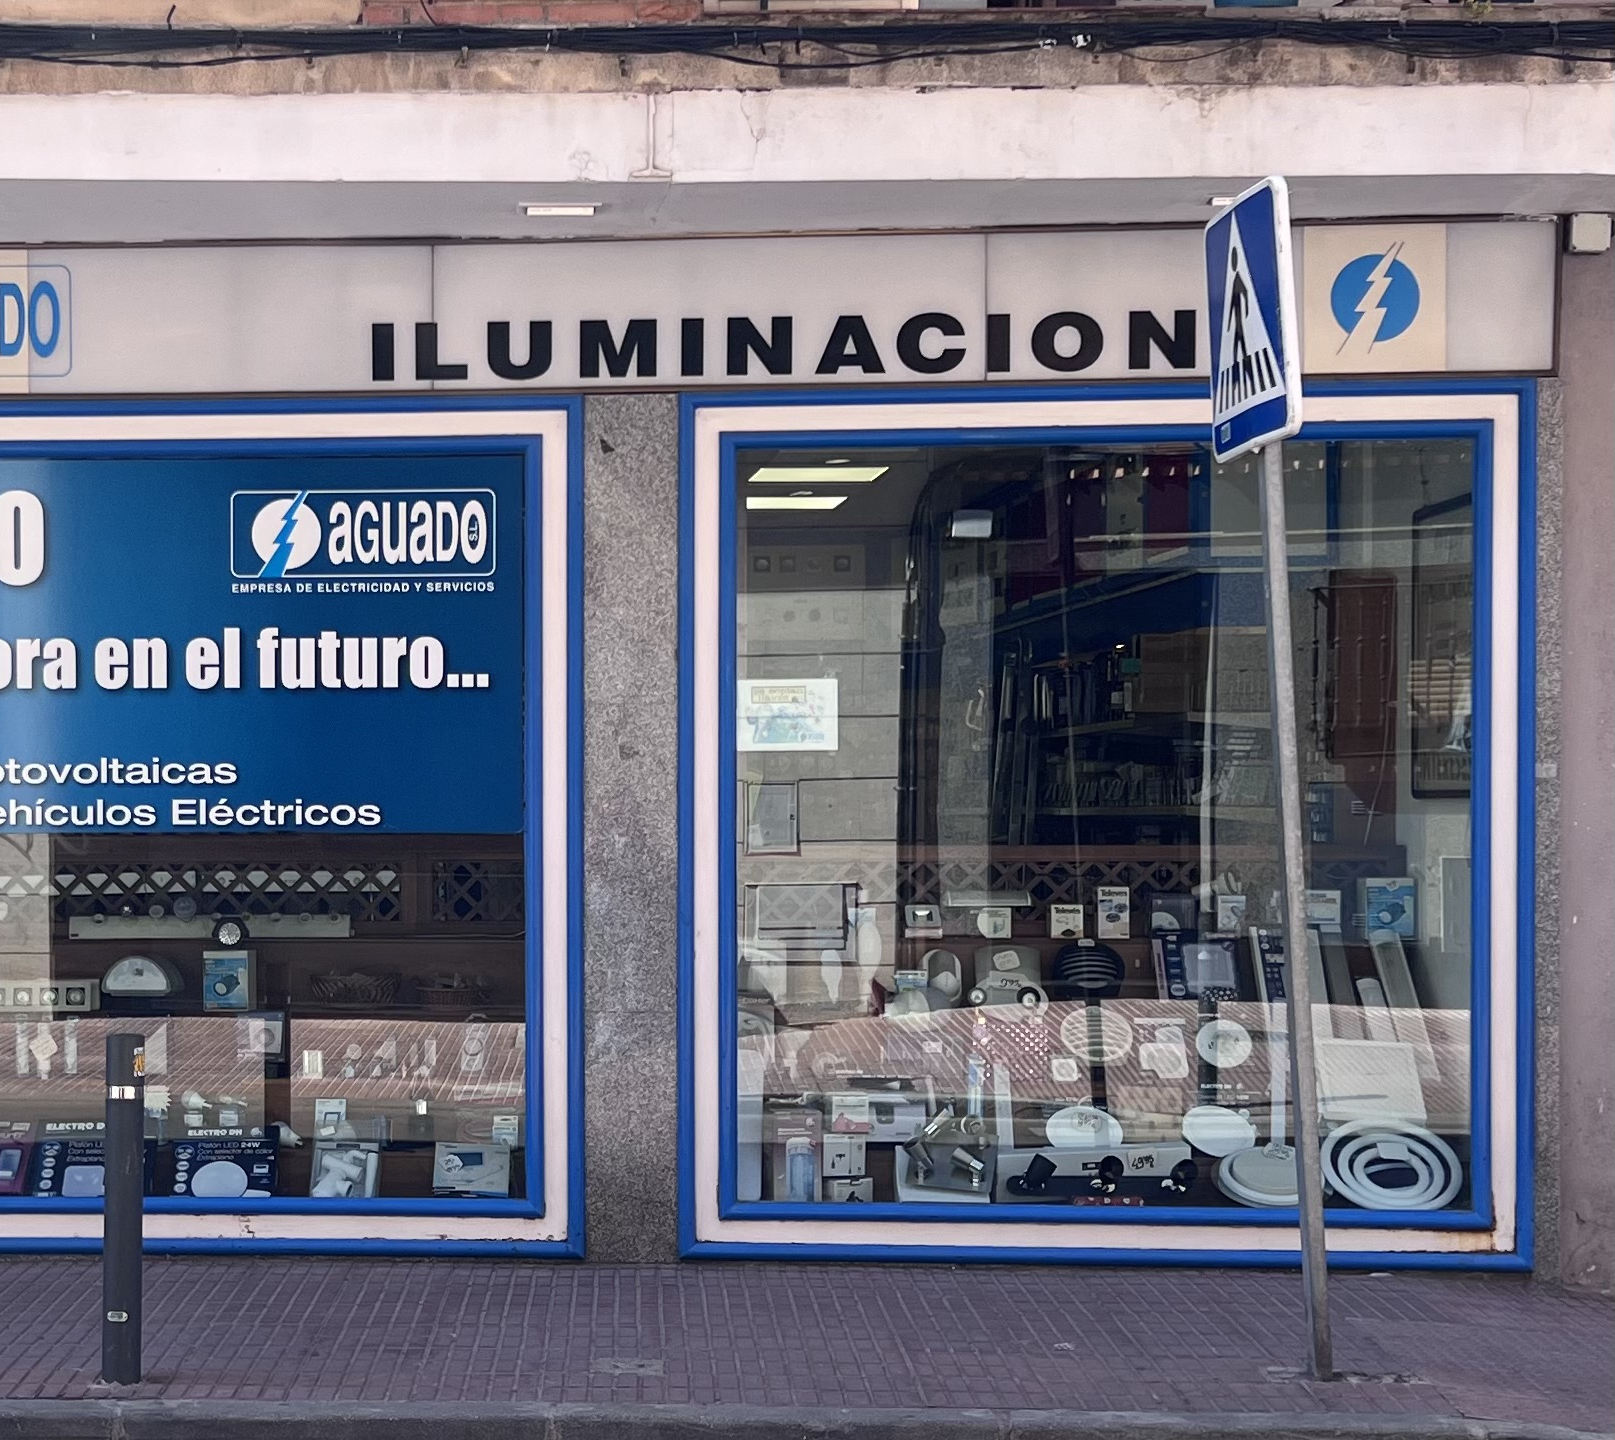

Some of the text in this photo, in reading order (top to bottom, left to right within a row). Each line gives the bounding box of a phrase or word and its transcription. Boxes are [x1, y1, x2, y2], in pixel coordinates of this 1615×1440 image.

[371, 310, 1198, 382] ILUMINACION
[231, 581, 495, 594] EMPRESA DE ELECTRICIDAD Y SERVICIOS
[94, 637, 168, 690] en
[185, 627, 241, 690] el
[256, 627, 490, 690] futuro...
[172, 798, 382, 827] Eléctricos
[45, 1122, 95, 1131] ELECTRO
[187, 1128, 228, 1137] ELECTRO
